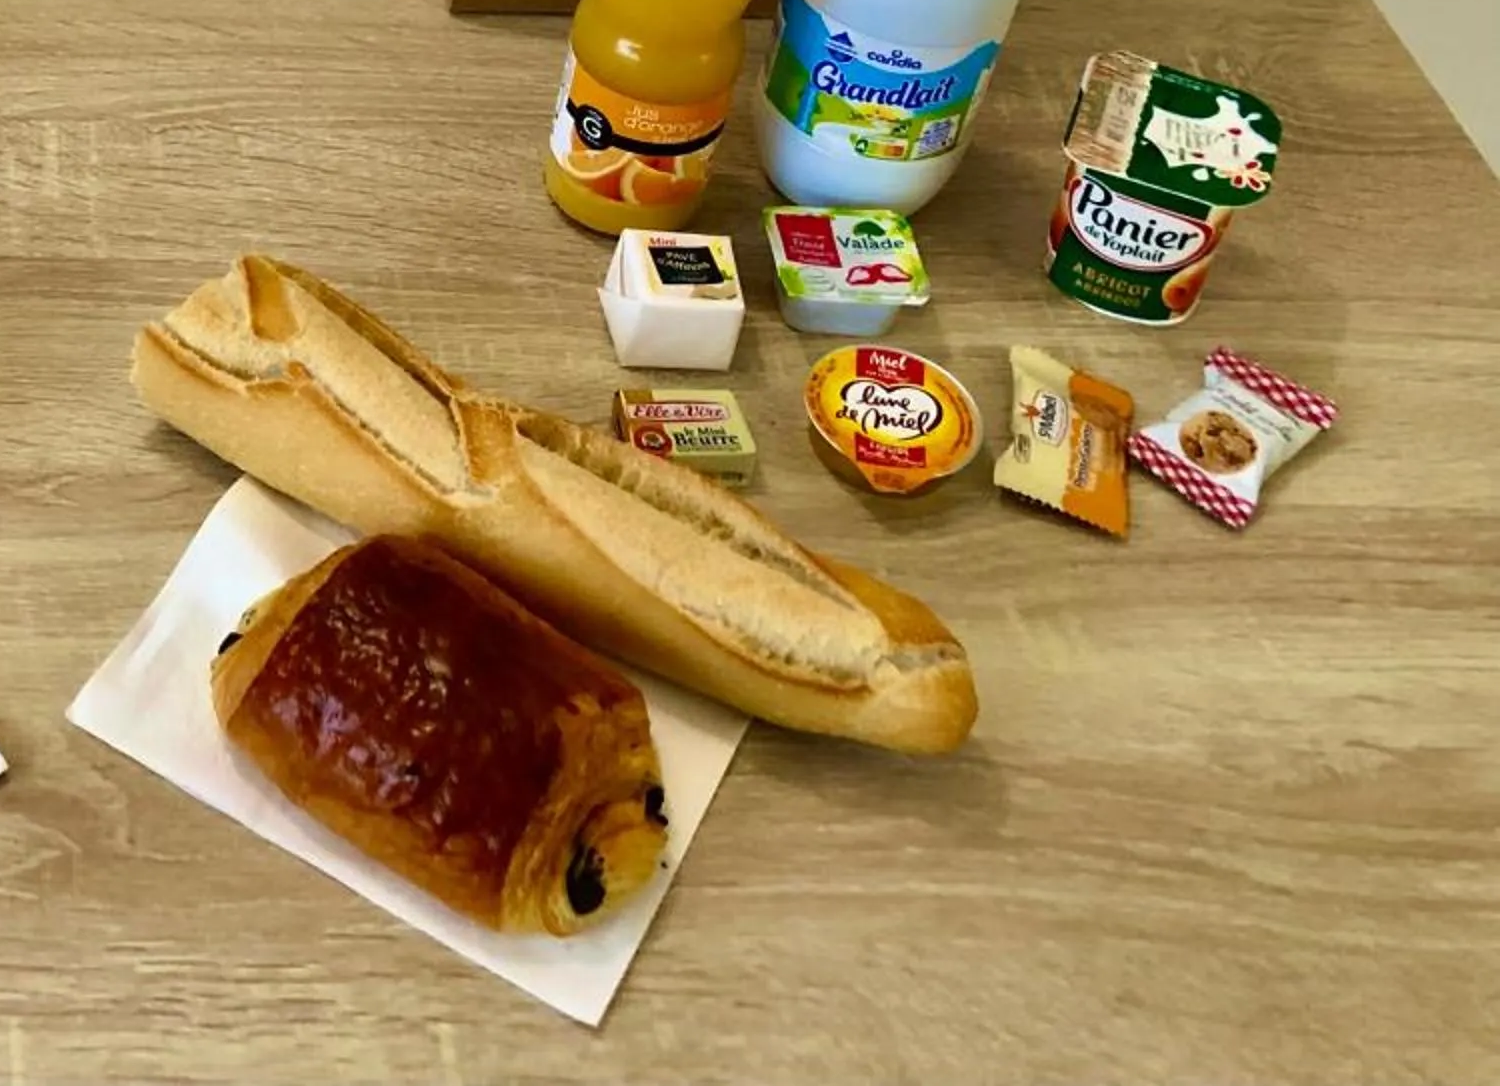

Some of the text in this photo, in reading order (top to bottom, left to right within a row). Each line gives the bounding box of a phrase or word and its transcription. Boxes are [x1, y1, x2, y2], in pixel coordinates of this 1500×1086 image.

[867, 49, 924, 70] candia
[582, 116, 603, 140] G
[1076, 177, 1199, 252] Panier
[836, 234, 905, 251] Valade
[1084, 224, 1167, 264] de Yoplait
[1072, 262, 1152, 298] ABRICOT
[869, 351, 908, 371] Miel
[835, 404, 859, 421] de
[671, 431, 740, 446] Beurre
